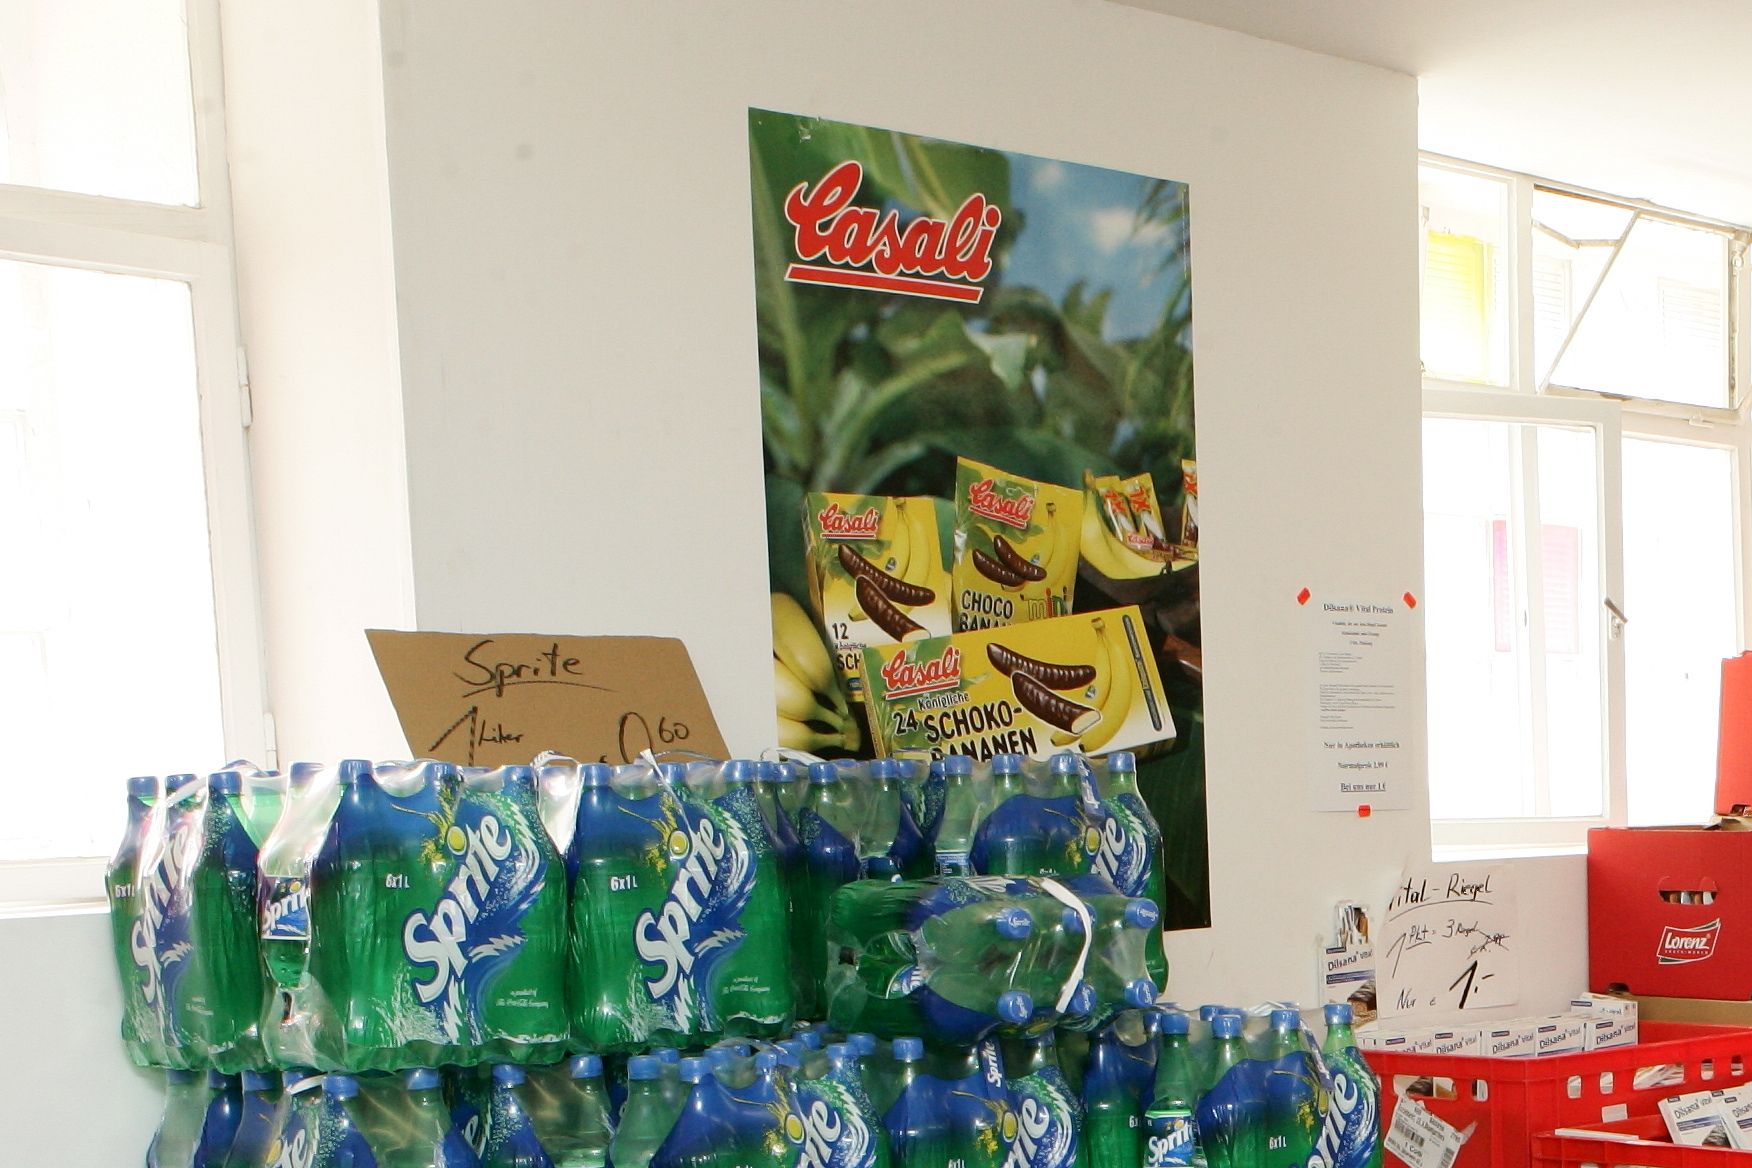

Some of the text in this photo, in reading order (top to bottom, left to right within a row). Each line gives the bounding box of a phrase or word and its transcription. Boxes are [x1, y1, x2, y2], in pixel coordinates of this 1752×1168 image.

[785, 160, 1001, 282] Casali
[818, 502, 880, 533] Casali
[967, 478, 1035, 525] Casali
[961, 589, 1014, 620] CHOCO
[832, 622, 849, 640] 12
[454, 640, 584, 697] Sprite
[881, 646, 961, 690] Casali
[892, 699, 1024, 744] 24 SCHOKO-
[404, 813, 512, 1003] Sprite
[634, 815, 725, 1000] Sprite
[1664, 931, 1710, 951] Lorenz
[986, 1039, 1002, 1088] Sprite
